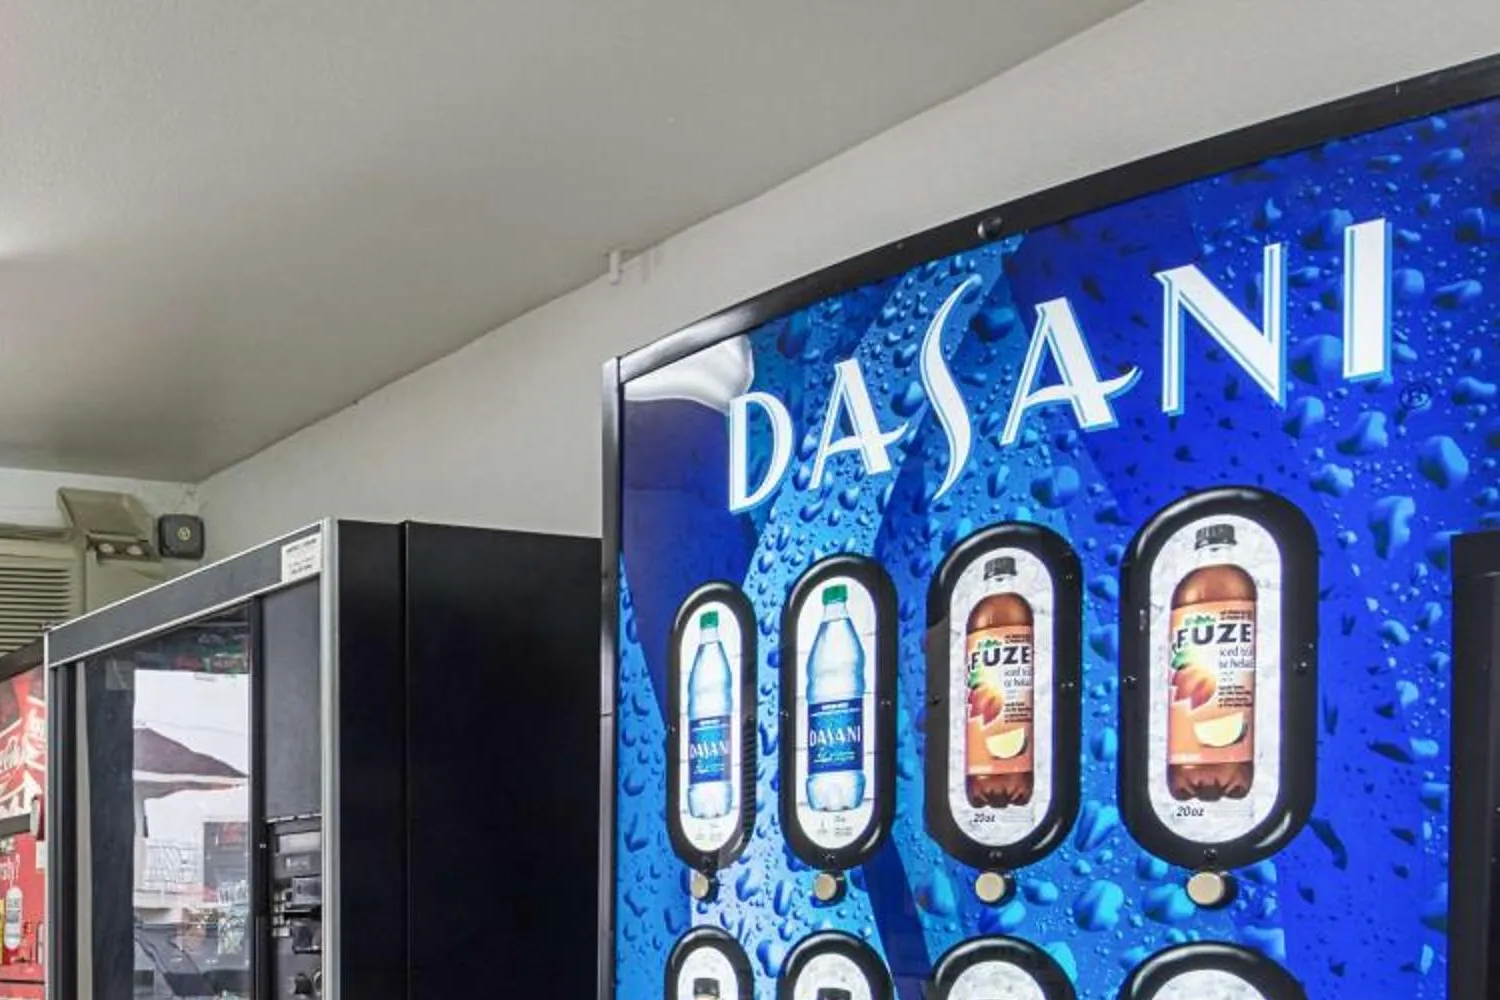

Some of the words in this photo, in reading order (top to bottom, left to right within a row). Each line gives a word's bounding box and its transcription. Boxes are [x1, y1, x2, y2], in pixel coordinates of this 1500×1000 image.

[728, 217, 1392, 514] DASANI
[1176, 623, 1252, 649] FUZE
[970, 645, 1031, 671] FUZE
[809, 726, 861, 747] DASANI
